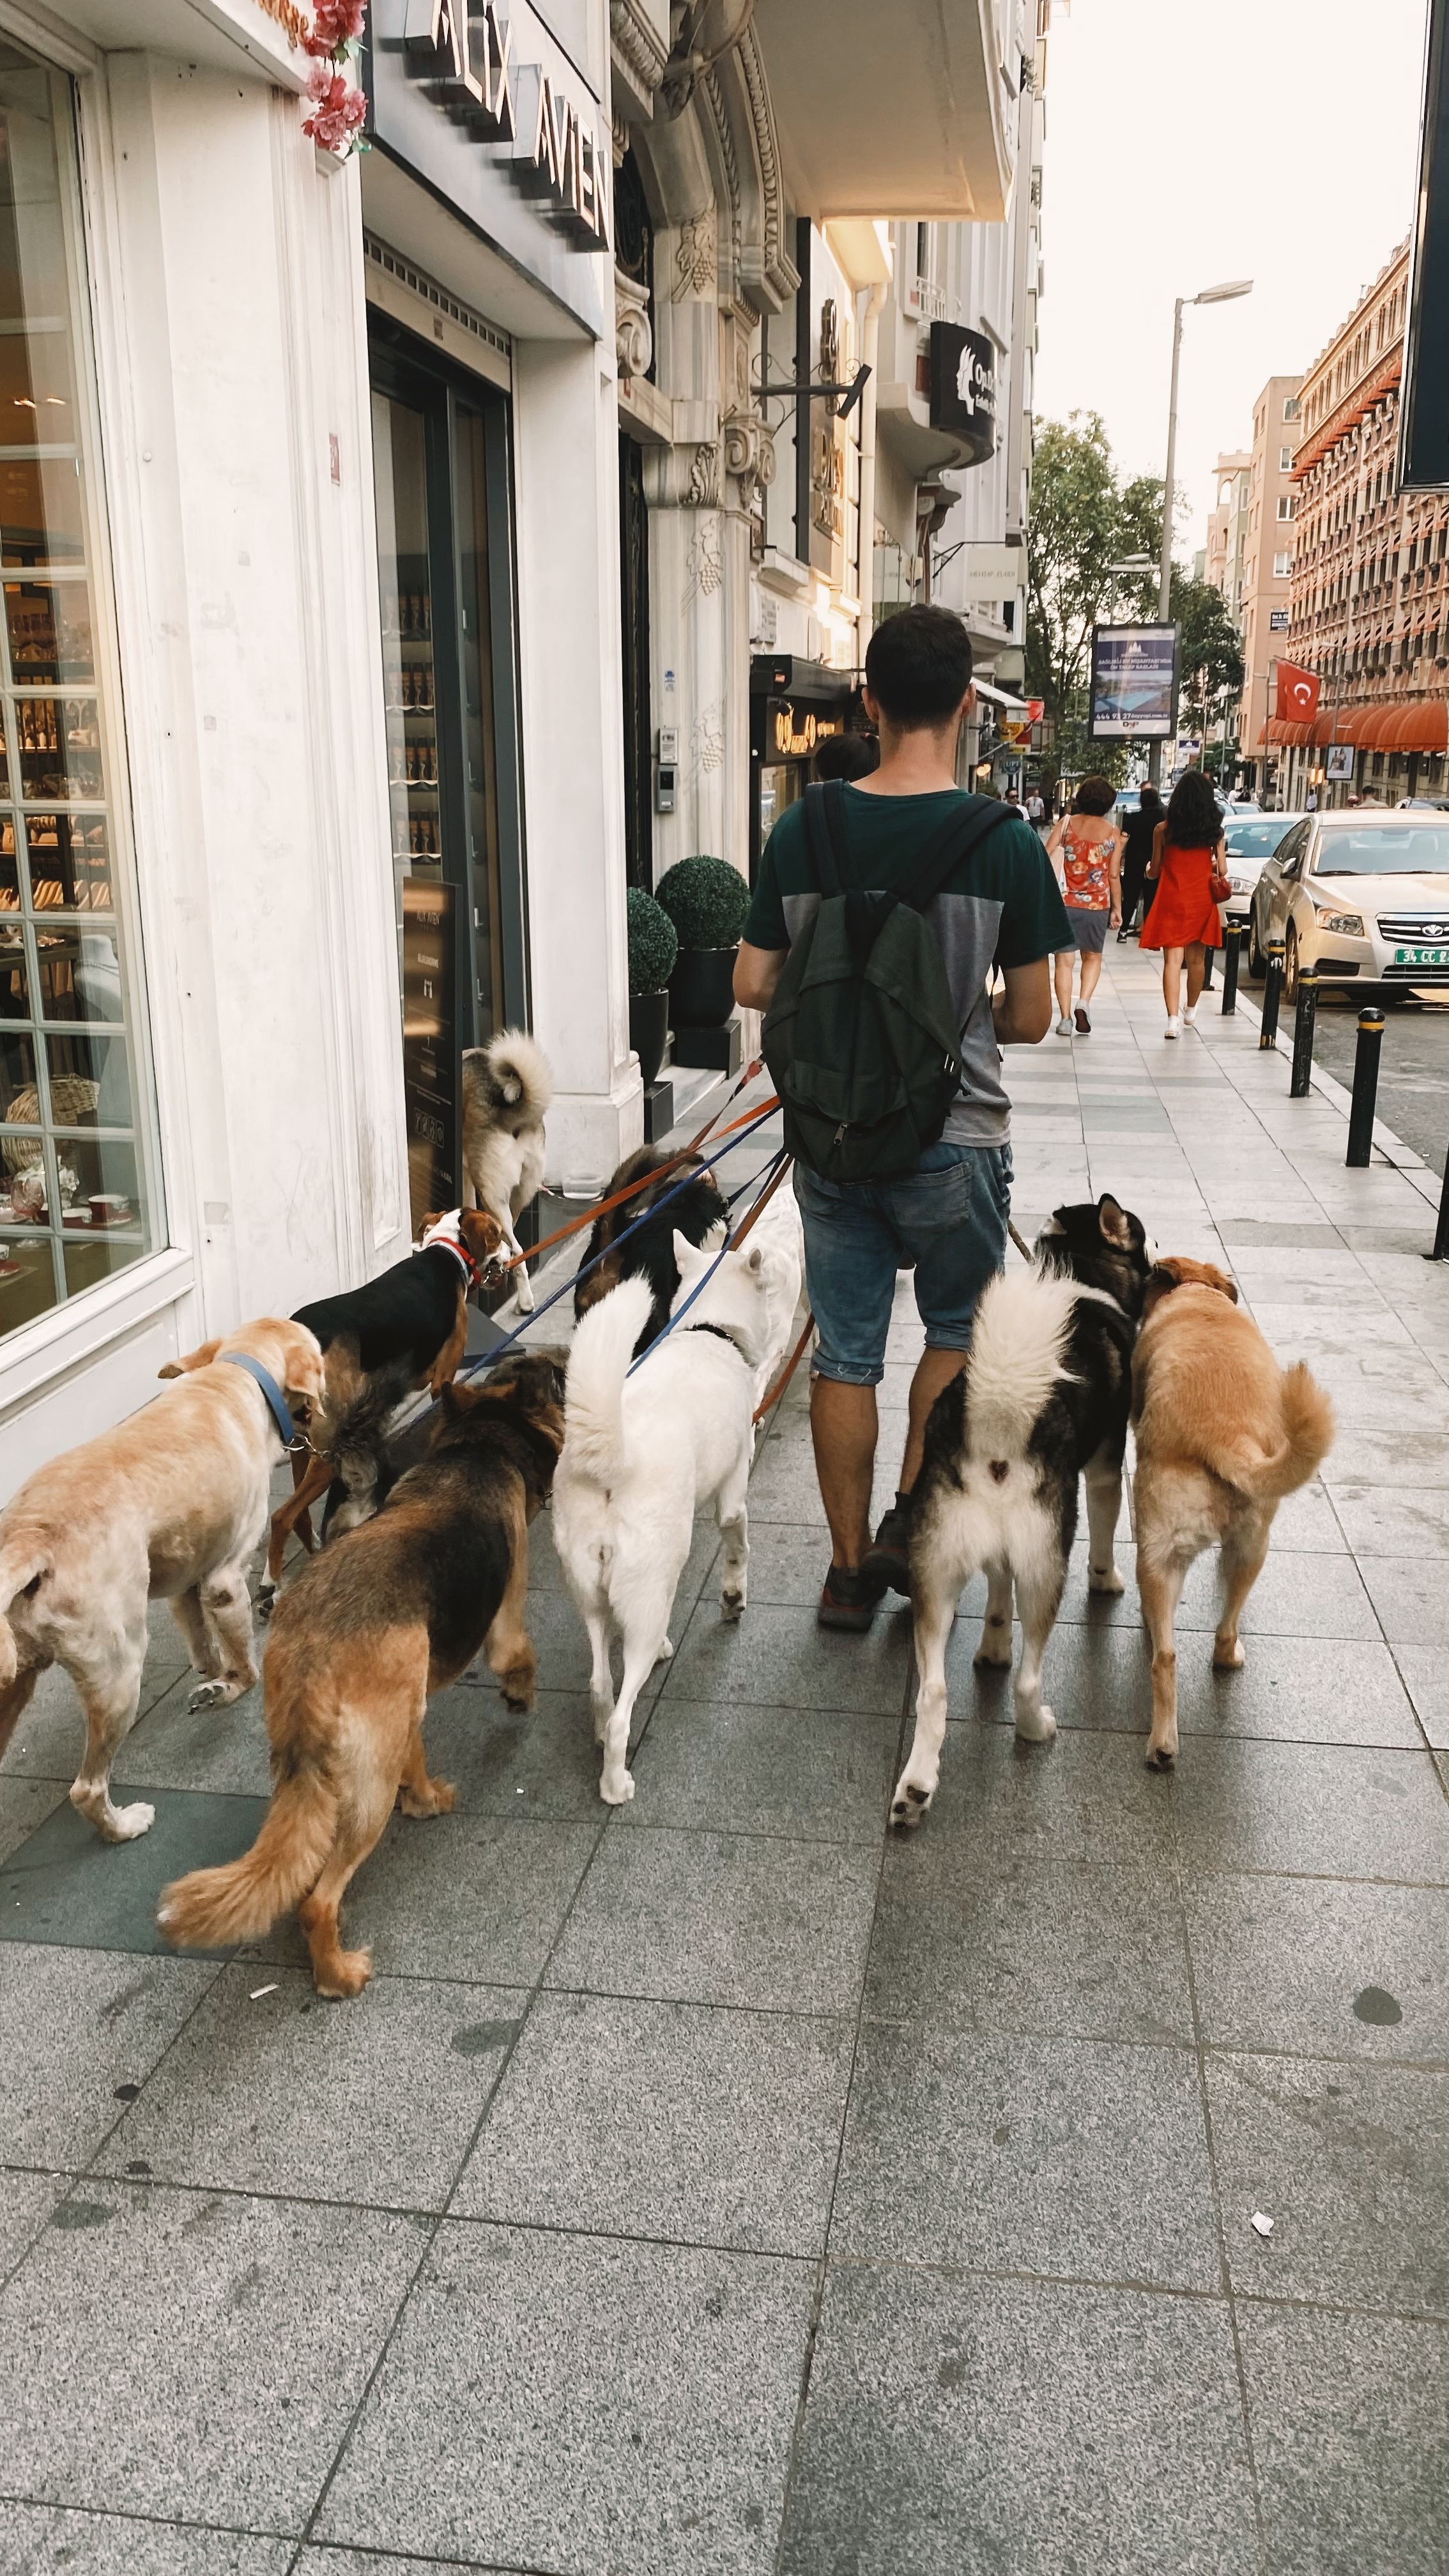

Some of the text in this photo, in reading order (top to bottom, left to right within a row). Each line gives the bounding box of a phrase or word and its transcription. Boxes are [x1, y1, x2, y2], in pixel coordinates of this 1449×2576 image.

[525, 64, 611, 252] AVIEN
[1403, 950, 1417, 962] 34
[1421, 950, 1436, 962] CC
